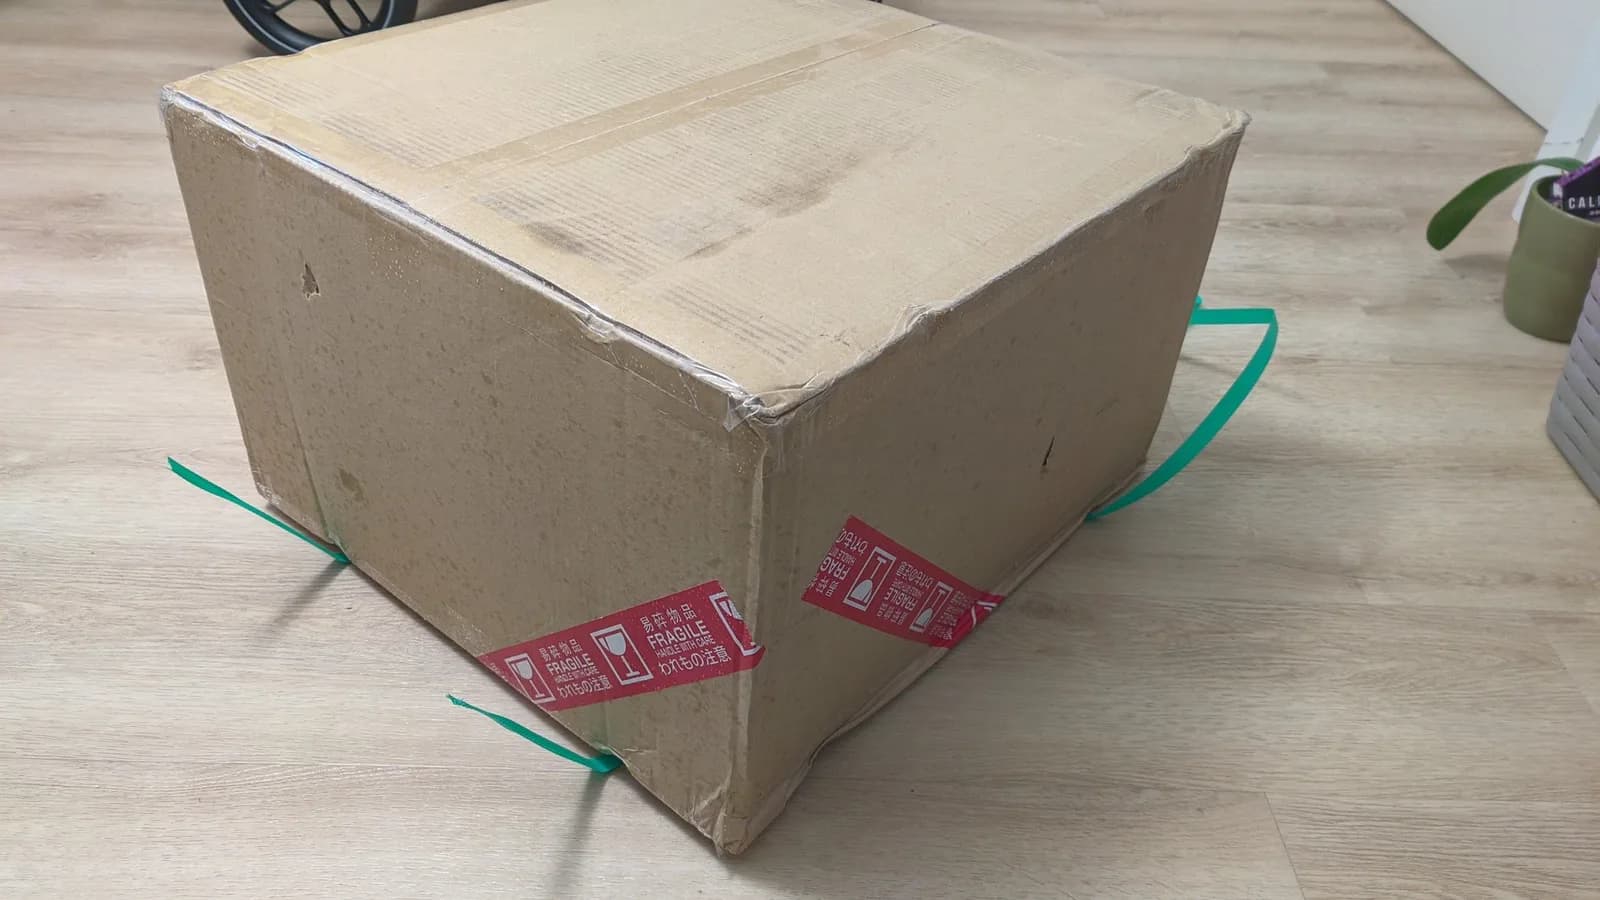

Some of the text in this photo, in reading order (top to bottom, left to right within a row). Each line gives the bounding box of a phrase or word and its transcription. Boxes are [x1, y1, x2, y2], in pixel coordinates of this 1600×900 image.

[820, 557, 850, 580] FRAG
[883, 587, 918, 611] FRAGILE
[640, 603, 697, 633] 易碎物品
[646, 620, 710, 650] FRAGILE
[655, 634, 716, 657] HANDLE WITH CARE
[545, 653, 594, 676] FRAGILE
[658, 645, 732, 676] われもの注意
[557, 675, 613, 699] われもの注意
